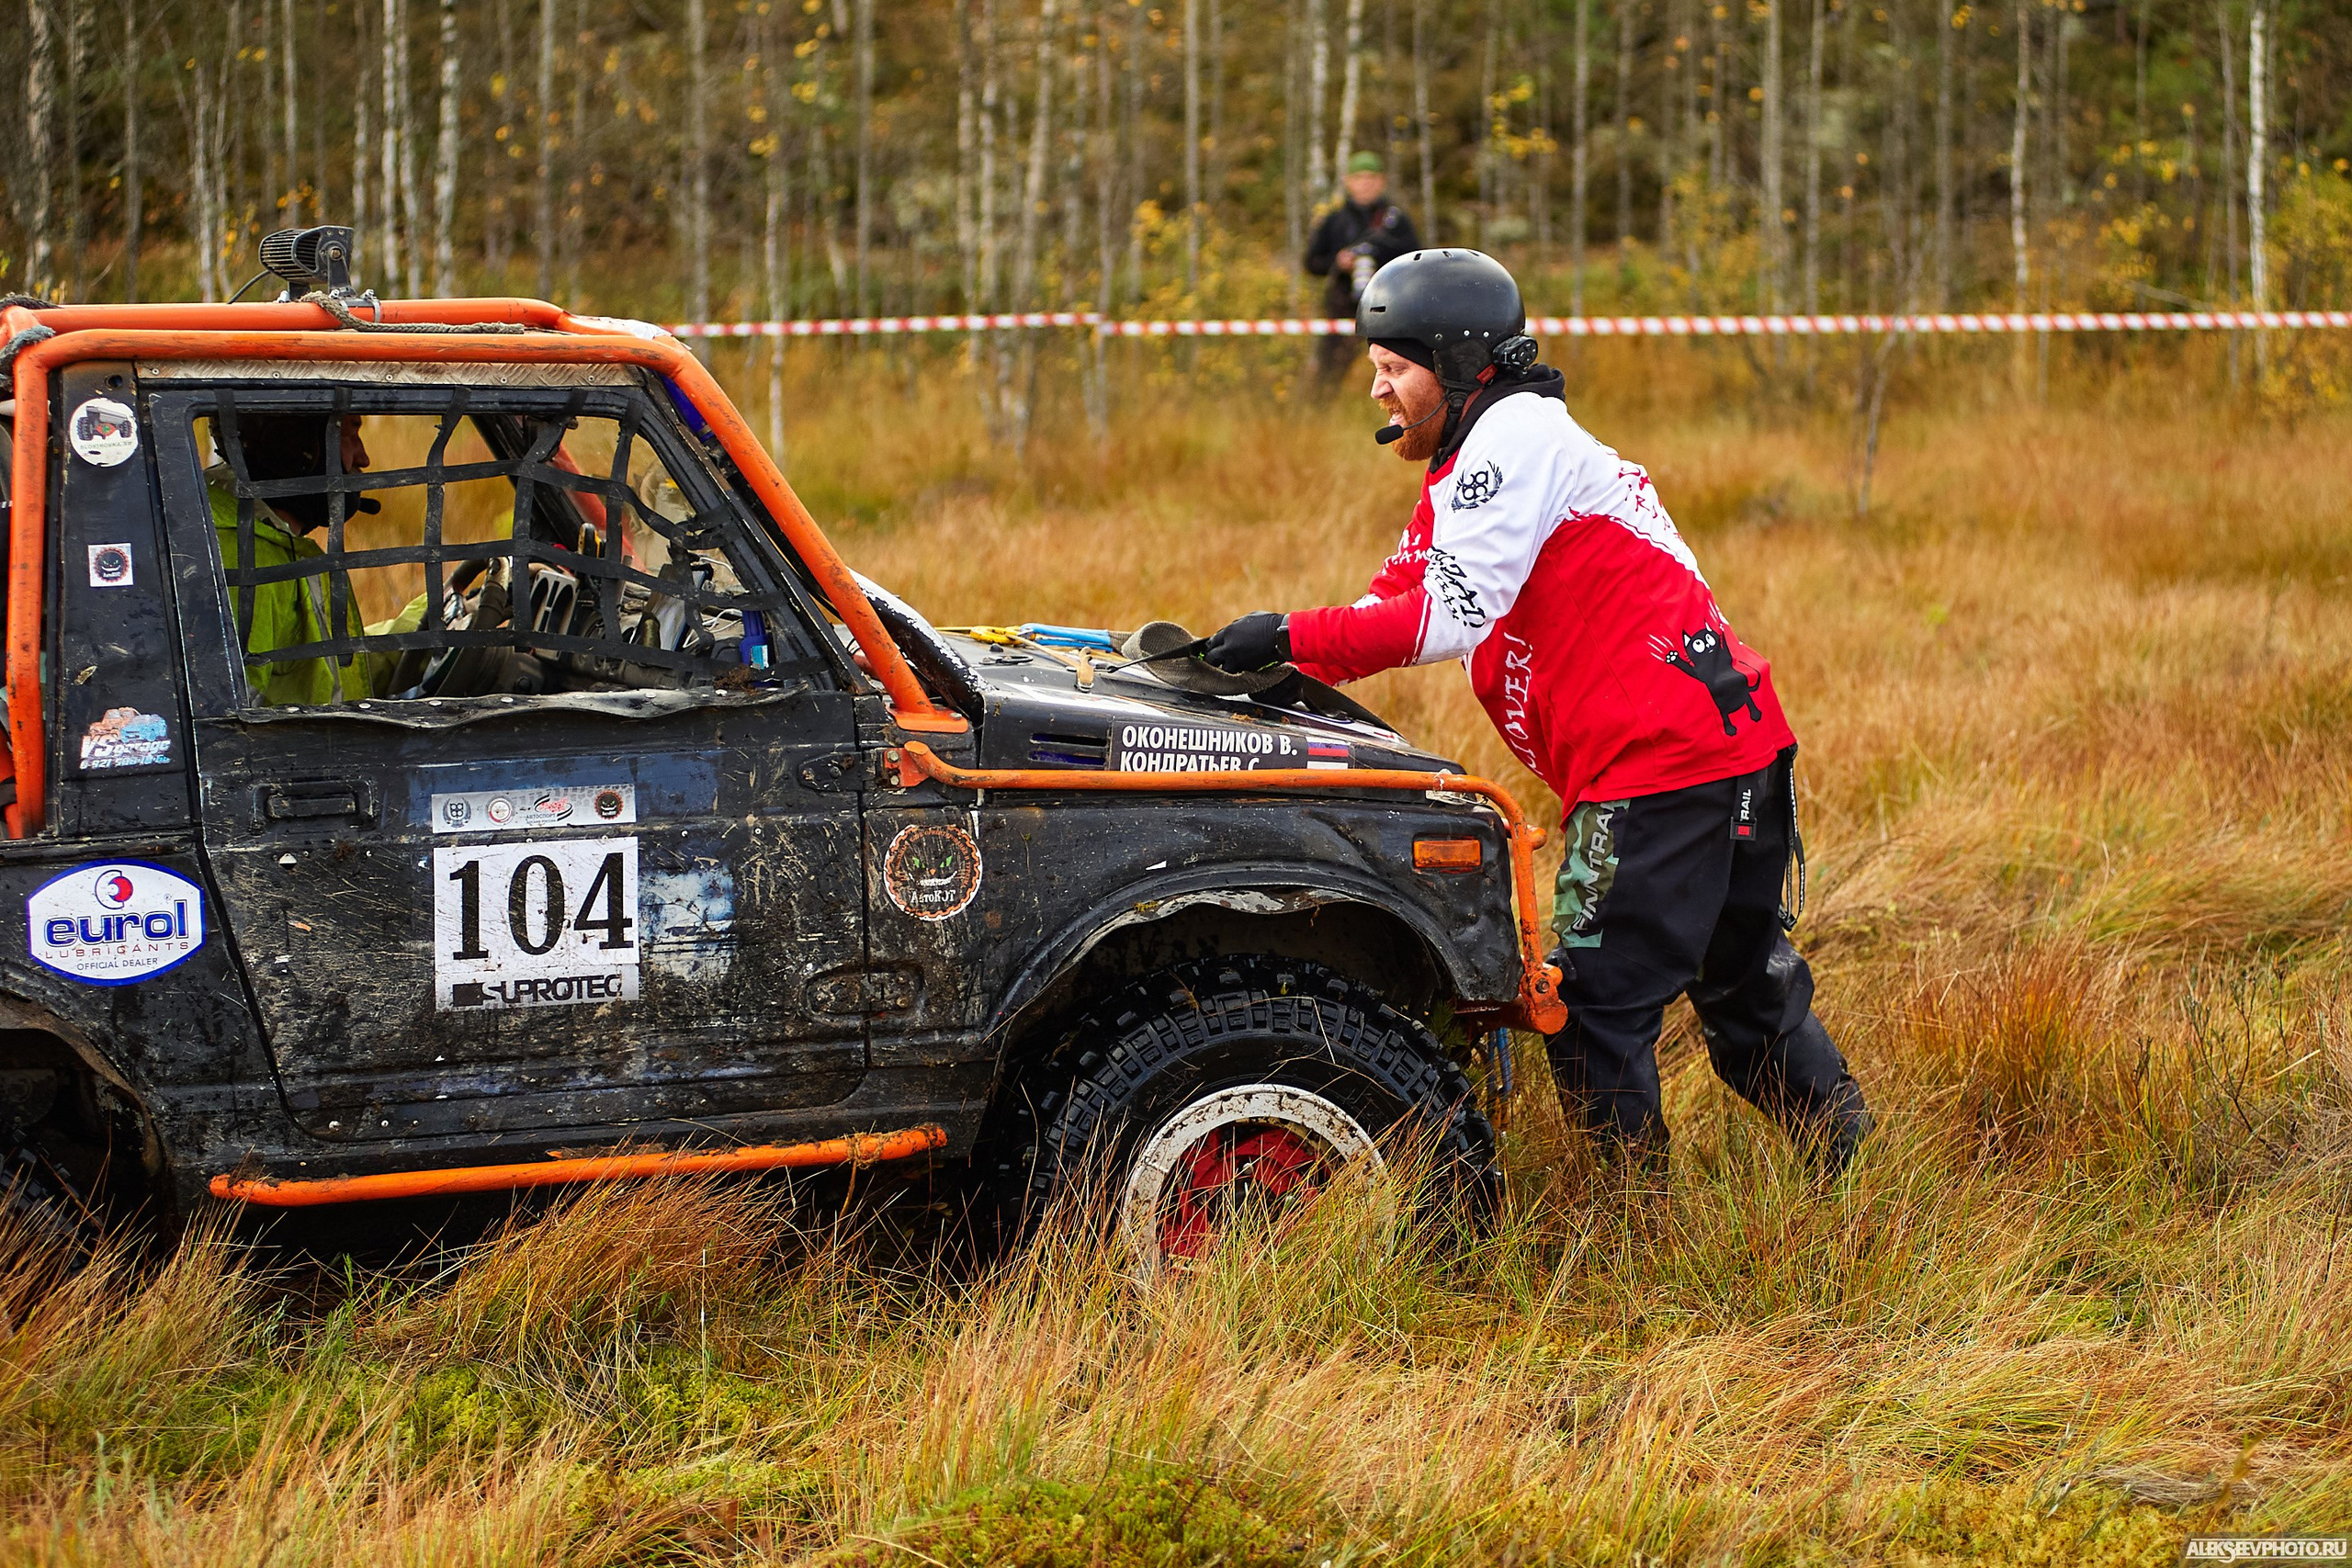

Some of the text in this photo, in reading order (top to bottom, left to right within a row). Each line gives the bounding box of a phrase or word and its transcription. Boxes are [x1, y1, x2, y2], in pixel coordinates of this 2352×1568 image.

[1122, 726, 1298, 756] ОКОНЕШНИКОВ В.
[1119, 750, 1241, 772] КОНДРАТЬЕВ
[1740, 788, 1752, 822] RAIL
[1571, 801, 1615, 931] FINNTRAI
[449, 852, 635, 960] 104
[44, 899, 189, 947] eurol
[45, 942, 189, 959] LUBRICANTS
[76, 957, 158, 971] OFFICIAL DEALER
[480, 975, 623, 1004] SUPROTEC
